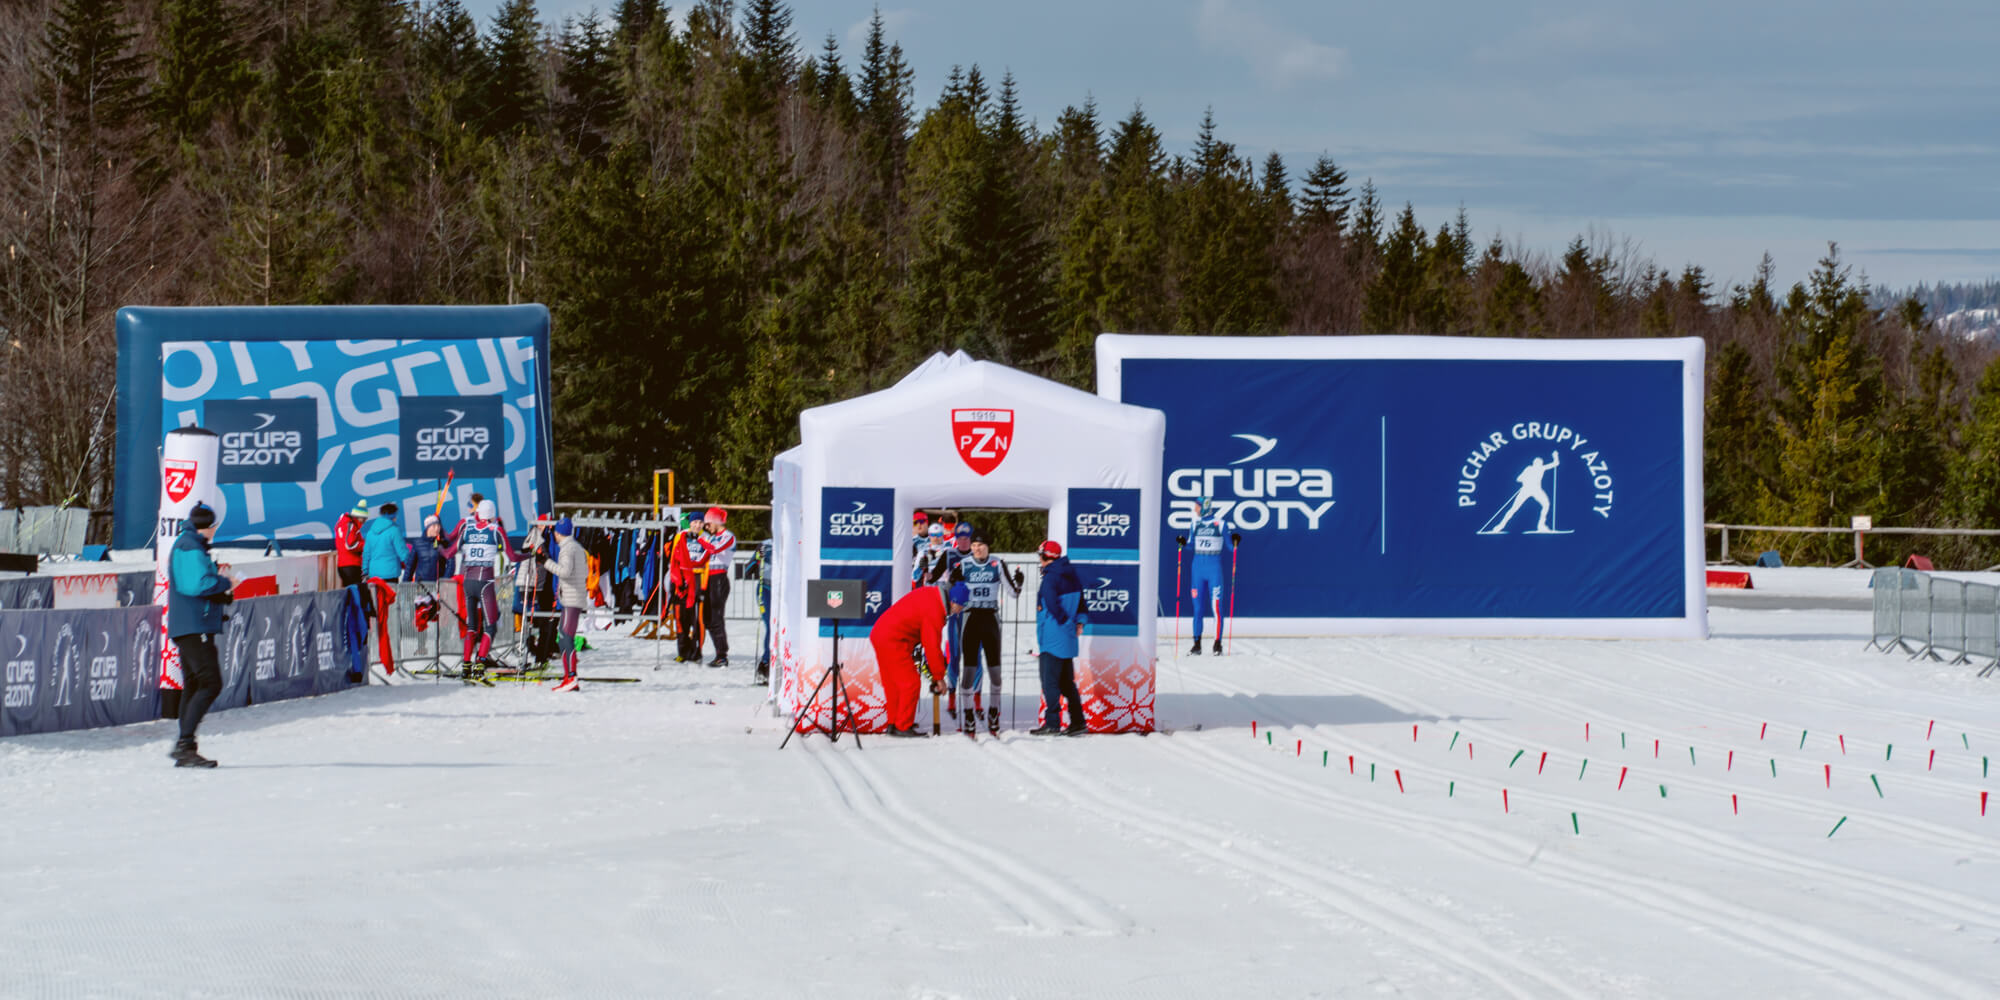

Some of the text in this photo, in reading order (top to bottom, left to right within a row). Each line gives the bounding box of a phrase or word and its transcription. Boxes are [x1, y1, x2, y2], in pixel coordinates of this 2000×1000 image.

[1458, 421, 1614, 519] PUCHAR GRUPY AZOTY
[972, 587, 990, 597] 68
